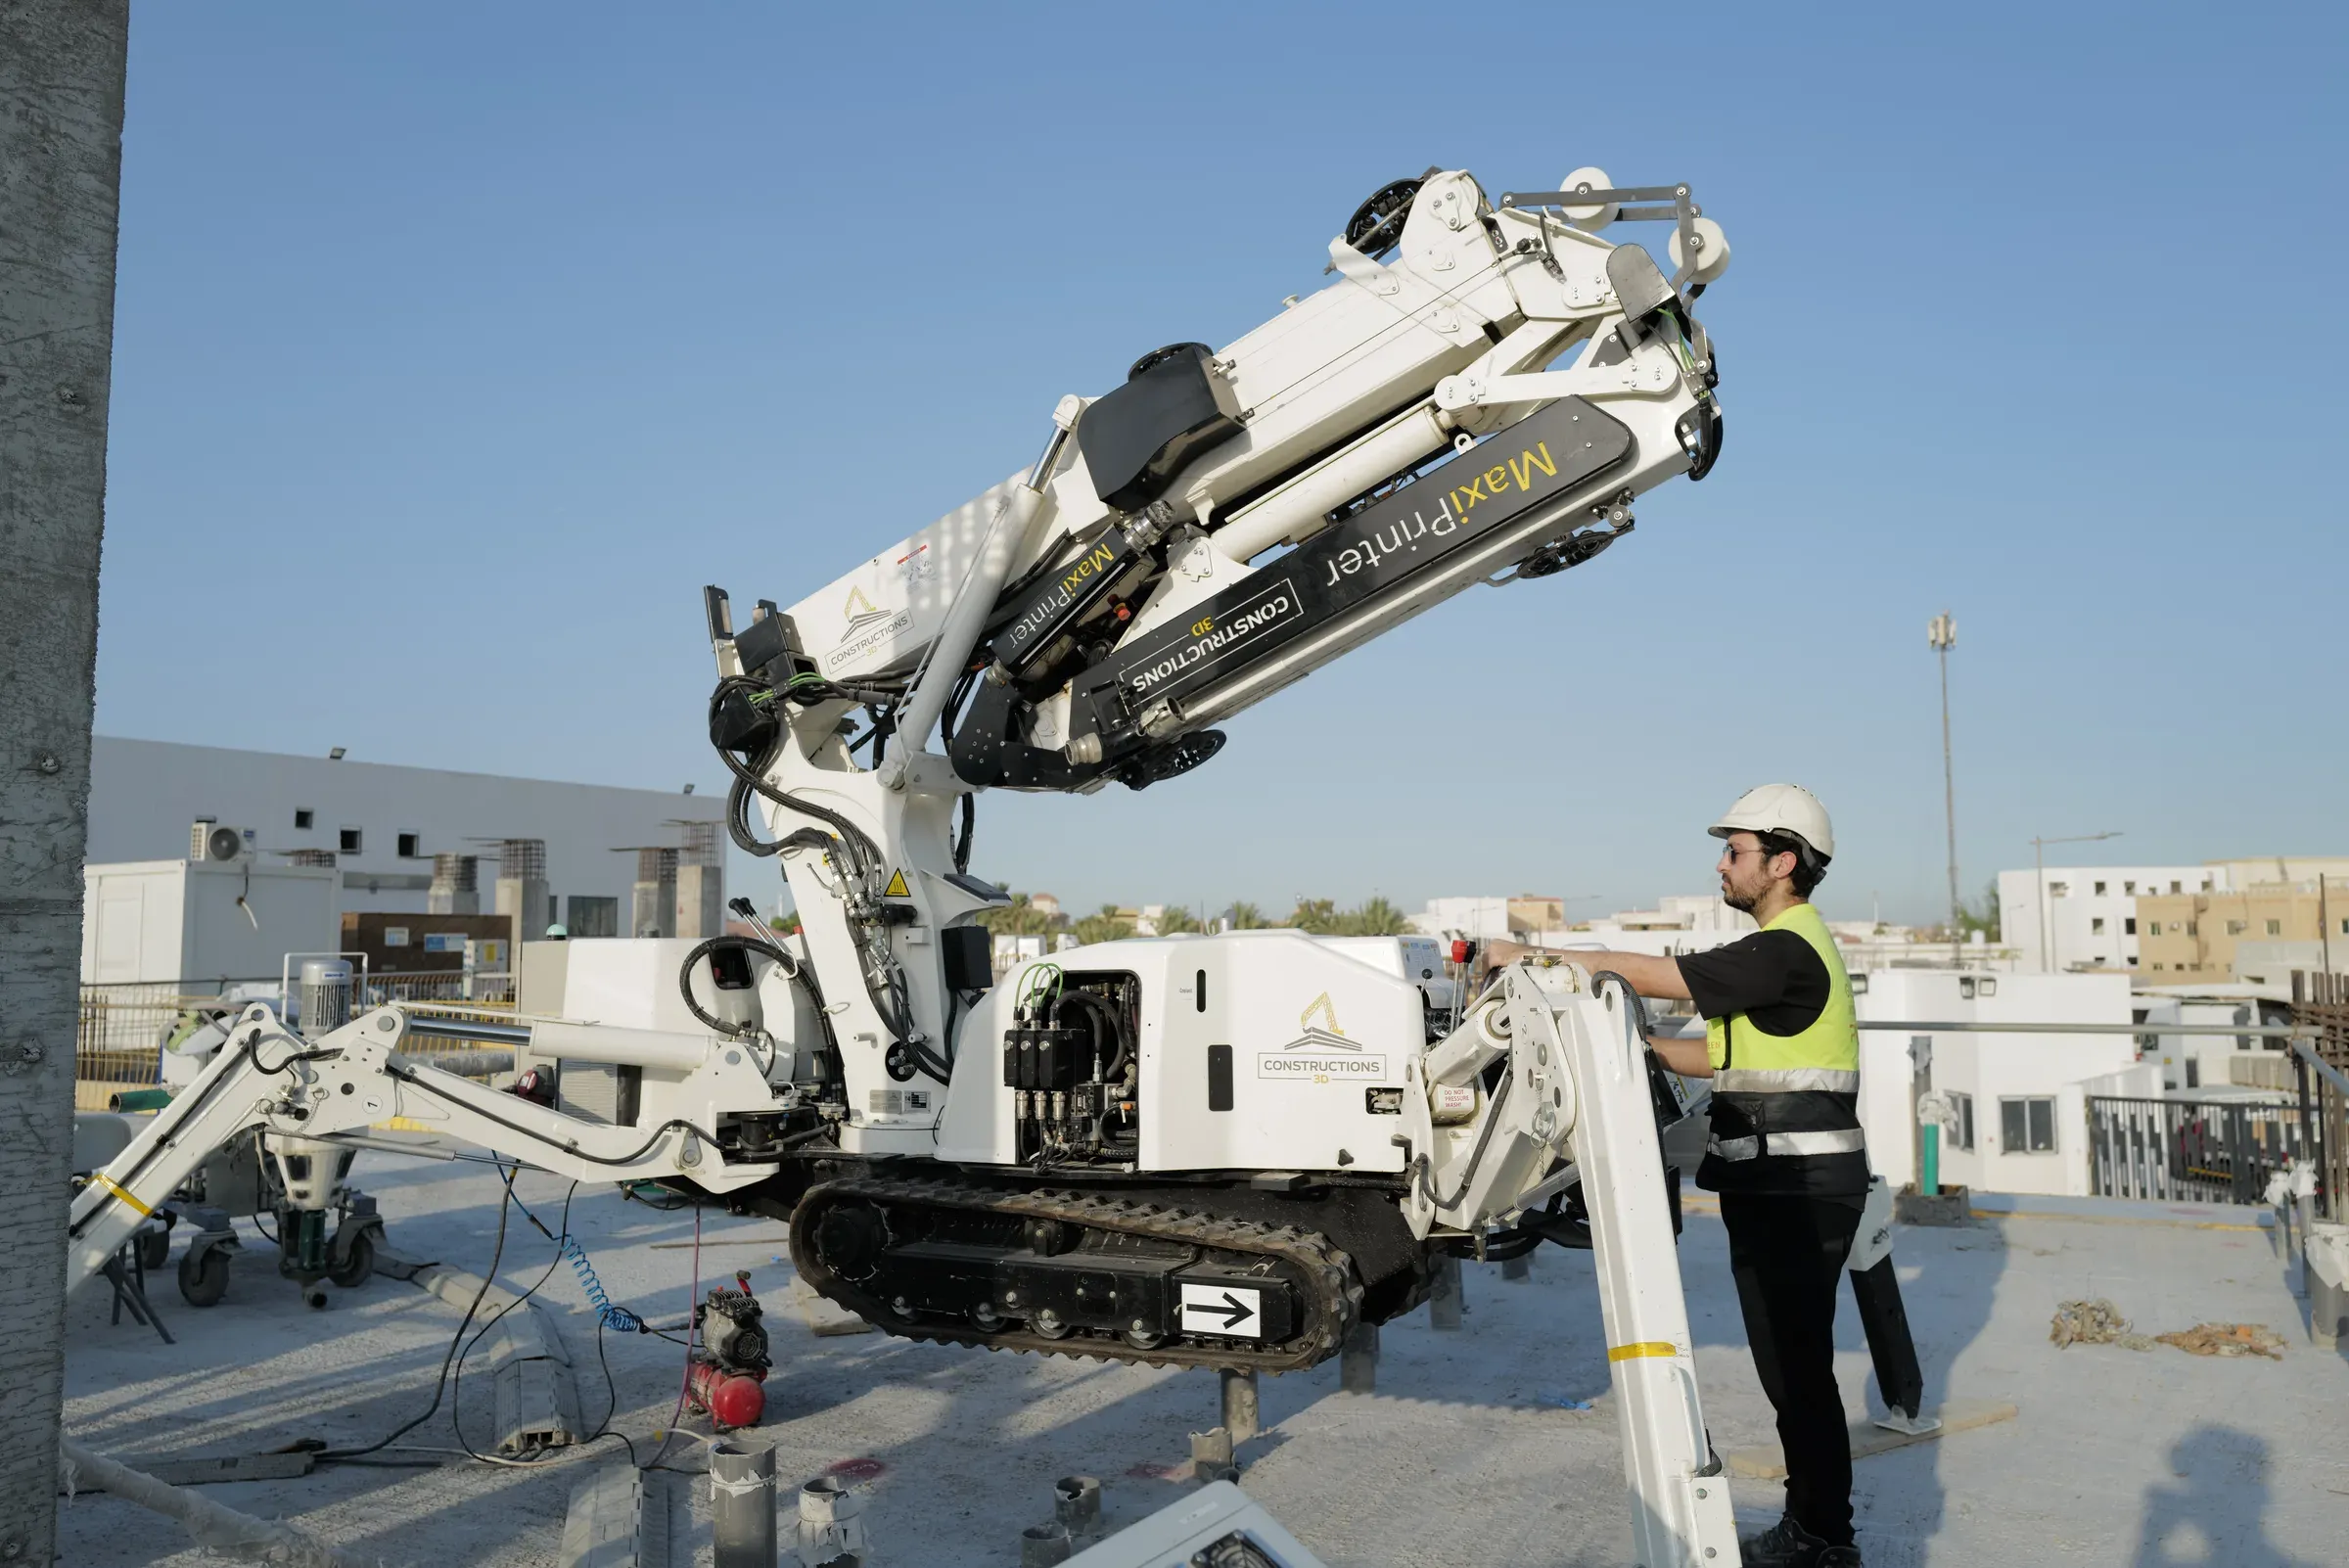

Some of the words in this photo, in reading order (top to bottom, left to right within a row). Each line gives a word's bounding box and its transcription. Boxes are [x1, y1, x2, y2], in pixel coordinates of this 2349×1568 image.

[1325, 440, 1558, 586] MaxiPrinter
[1010, 543, 1115, 649] MaxiPrinter
[831, 616, 909, 666] CONSTRUCTIONS
[1191, 616, 1215, 636] 3D
[866, 646, 878, 657] 3D
[1132, 595, 1289, 693] CONSTRUCTIONS
[1264, 1060, 1380, 1072] CONSTRUCTIONS
[1313, 1075, 1329, 1084] 3D
